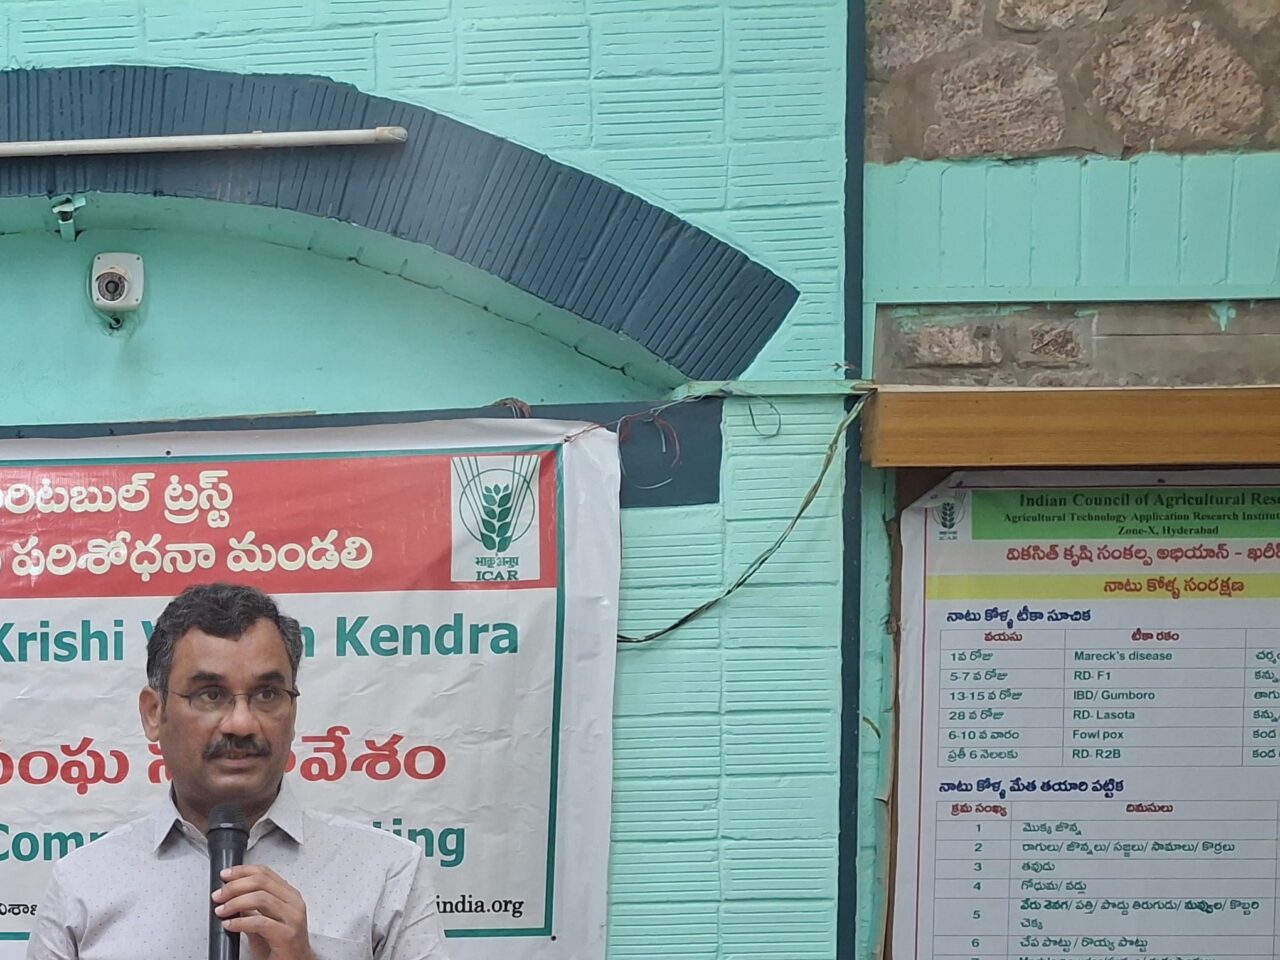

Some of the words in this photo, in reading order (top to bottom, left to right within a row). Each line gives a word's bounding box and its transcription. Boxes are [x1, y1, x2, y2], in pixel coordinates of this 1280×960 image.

[163, 470, 234, 528] ట్రస్ట్
[1020, 494, 1067, 507] Indian
[1072, 493, 1130, 507] Council
[1135, 493, 1150, 506] of
[1154, 492, 1245, 509] Agricultural
[1004, 512, 1066, 523] Agricultural
[1069, 512, 1127, 523] Technology
[1131, 511, 1190, 523] Application
[1193, 511, 1239, 521] Research
[1162, 526, 1219, 537] Hyderabad
[13, 530, 215, 582] పరిశోధనా
[227, 529, 373, 574] మండలి
[1006, 544, 1059, 561] వికసిత్
[1063, 544, 1094, 567] కృషి
[1097, 544, 1153, 566] సంకల్ప
[475, 570, 519, 581] ICAR
[1104, 579, 1143, 593] నాటు
[1184, 577, 1245, 597] సంరక్షణ
[947, 609, 982, 622] నాటు
[1017, 605, 1044, 622] టీకా
[335, 612, 519, 657] Kendra
[1128, 651, 1173, 661] disease
[1101, 690, 1156, 700] Gumboro
[949, 711, 966, 720] 28
[1096, 710, 1135, 720] Lasota
[948, 730, 976, 740] 6-10
[1072, 729, 1100, 739] Fowl
[1103, 731, 1125, 741] pox
[969, 750, 978, 760] 6
[939, 780, 973, 793] నాటు
[1009, 777, 1037, 792] మేత
[1091, 778, 1125, 798] పట్టిక
[974, 843, 983, 852] 2
[974, 863, 982, 872] 3
[973, 882, 982, 891] 4
[436, 895, 524, 918] india.org
[972, 910, 981, 920] 5
[971, 938, 980, 947] 6
